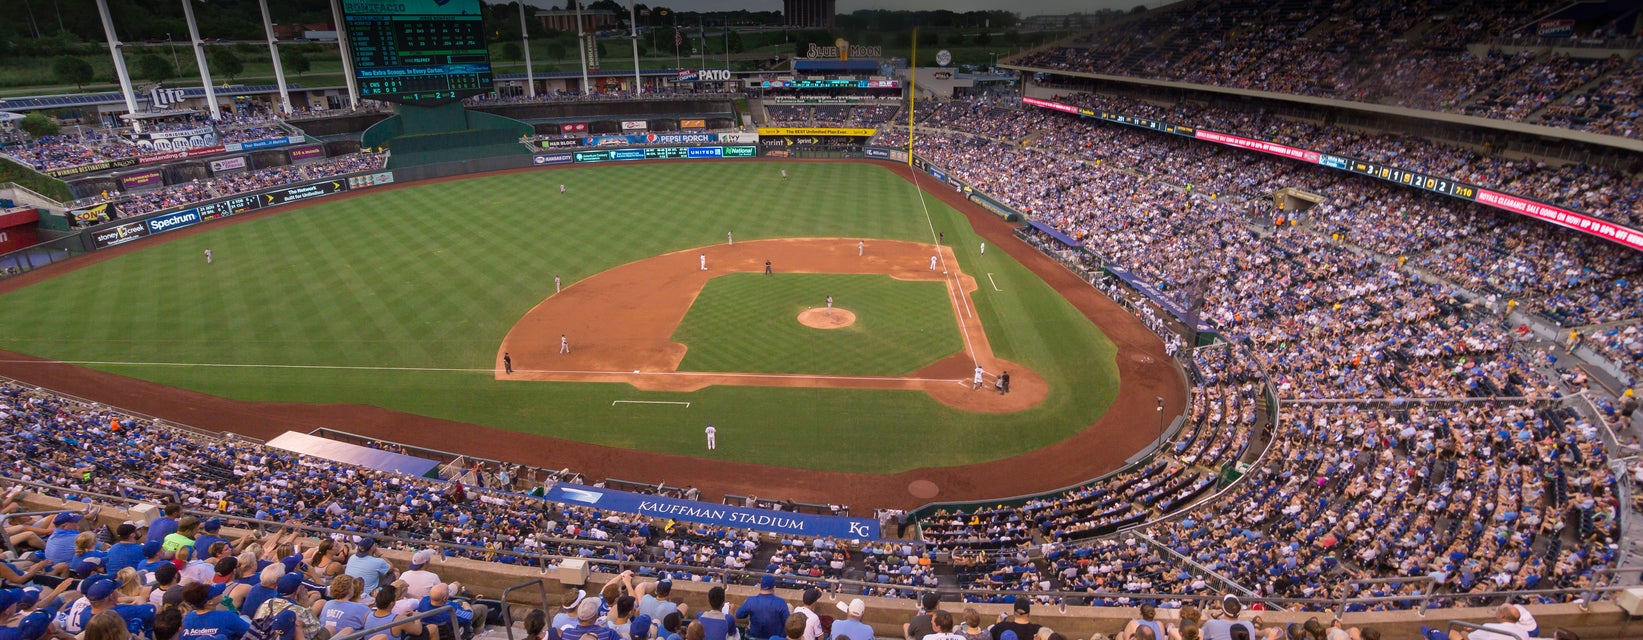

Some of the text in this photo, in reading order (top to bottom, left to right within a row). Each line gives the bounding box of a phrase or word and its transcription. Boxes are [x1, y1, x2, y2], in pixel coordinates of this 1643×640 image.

[346, 3, 406, 12] BONIFACIO
[1538, 26, 1571, 34] CHOPPER
[807, 42, 882, 59] BLUE MOON
[699, 70, 730, 80] PATIO
[150, 86, 185, 108] Lite
[139, 153, 178, 164] PrimeLending
[79, 163, 110, 173] DESTINATION!
[1368, 166, 1373, 174] 3
[1382, 169, 1388, 177] B
[1404, 174, 1410, 182] S
[1416, 177, 1422, 185] 2
[1439, 183, 1446, 191] 2
[1456, 186, 1472, 197] 7:10
[302, 190, 324, 198] Unlimited
[150, 212, 195, 231] Spectrum
[1479, 192, 1498, 203] ROYALS
[1498, 197, 1526, 211] CLEARANCE
[1526, 204, 1539, 214] SALE
[1540, 207, 1557, 219] GOING
[1557, 212, 1565, 222] ON
[1566, 215, 1581, 225] NOW!
[1580, 219, 1590, 228] UP
[1590, 221, 1600, 231] TO
[1615, 229, 1628, 240] OFF
[98, 232, 118, 241] stoney
[128, 224, 144, 233] creek
[638, 501, 805, 530] KAUFFMAN STADIUM
[848, 521, 870, 537] KC
[327, 609, 345, 620] BRETT
